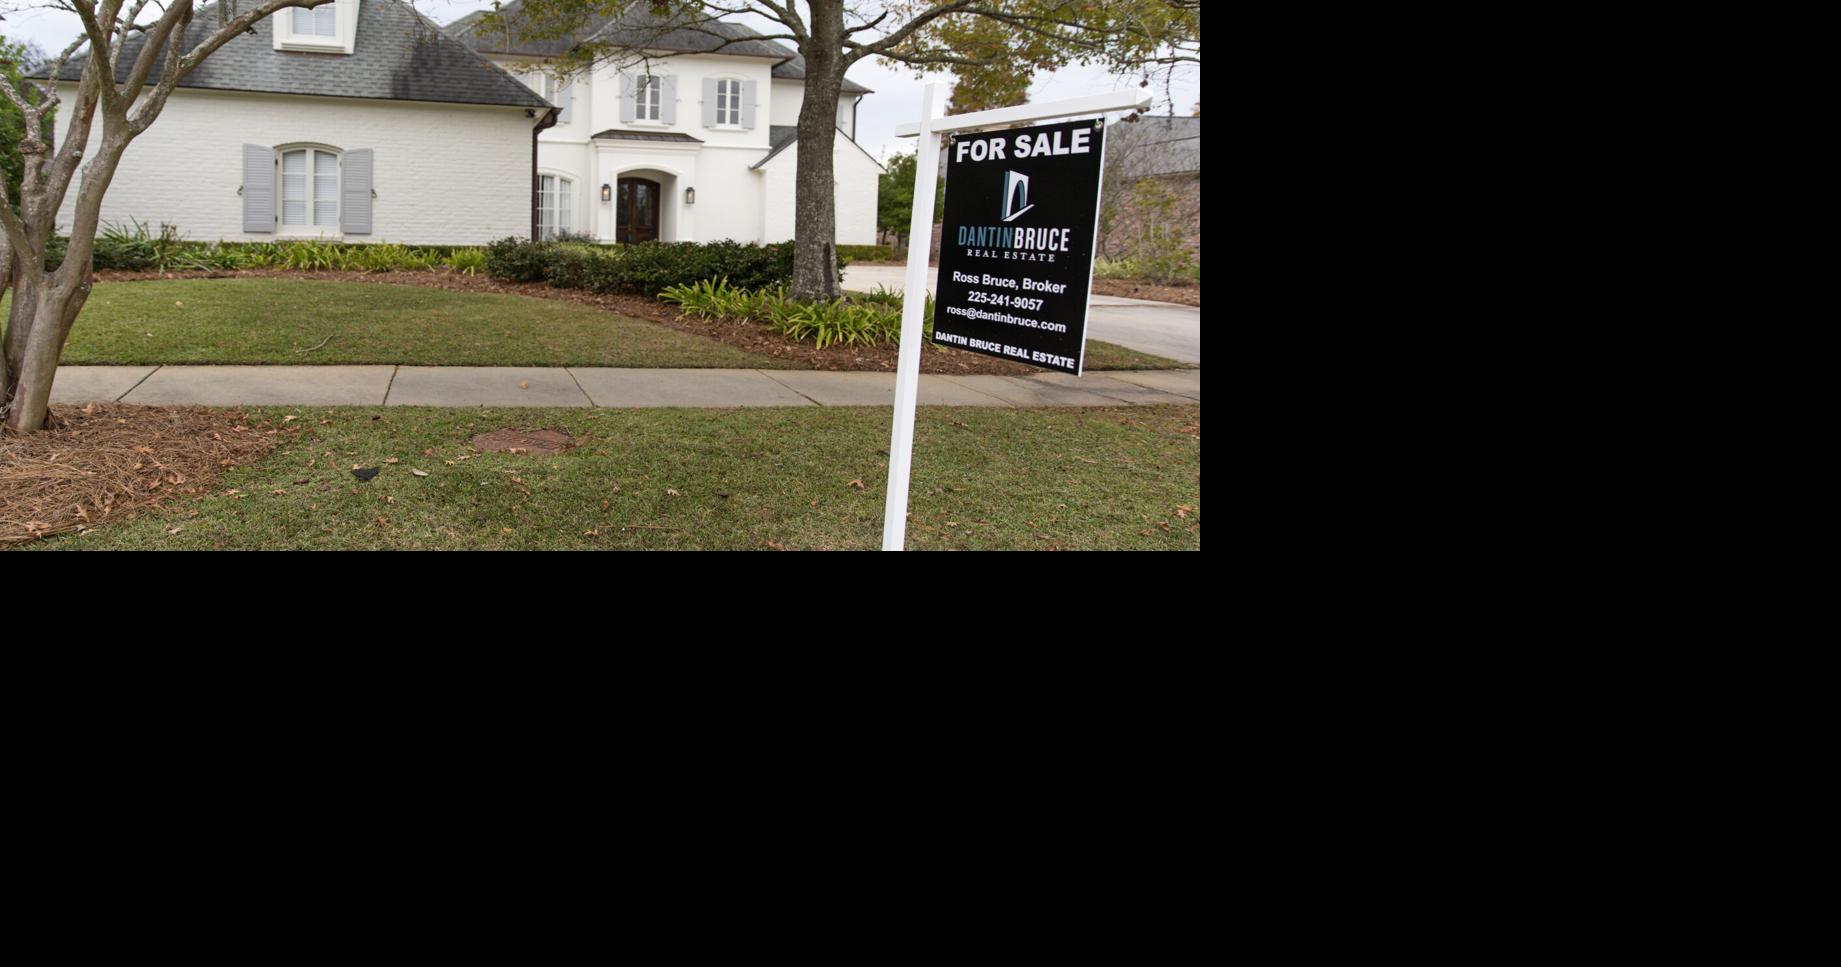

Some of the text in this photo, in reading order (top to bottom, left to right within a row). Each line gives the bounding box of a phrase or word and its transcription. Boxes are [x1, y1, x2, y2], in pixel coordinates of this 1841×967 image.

[956, 128, 1091, 163] FOR SALE
[967, 249, 1056, 262] REAL ESTATE
[952, 271, 1067, 294] Ross Bruce, Broker
[967, 291, 1044, 311] 225-241-9057
[946, 305, 1067, 333] ross@dantinbruce.com
[935, 331, 1075, 369] DANTIN BRUCE REAL ESTATE
